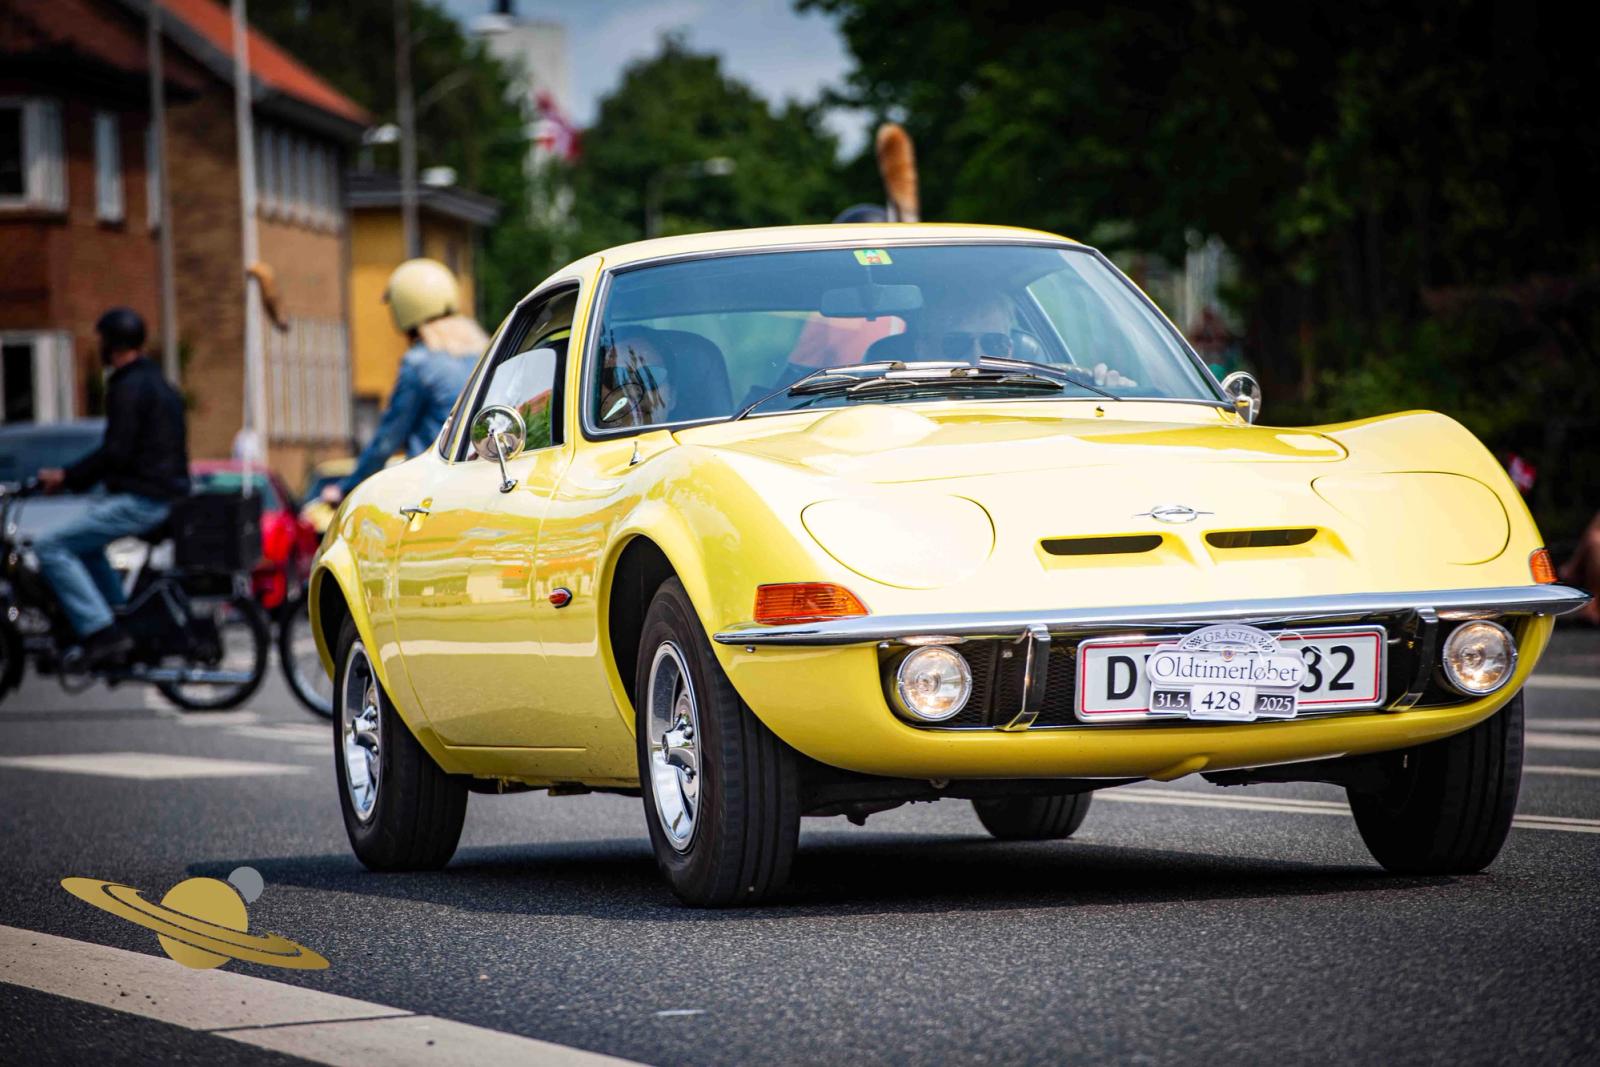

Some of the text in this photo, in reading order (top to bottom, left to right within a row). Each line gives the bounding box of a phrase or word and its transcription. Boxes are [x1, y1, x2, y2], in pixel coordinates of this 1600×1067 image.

[1203, 628, 1259, 644] GRÅSTEN
[1107, 655, 1152, 701] D
[1155, 656, 1299, 682] Oldtimerløbet
[1157, 691, 1292, 712] 31.5. 428 2025
